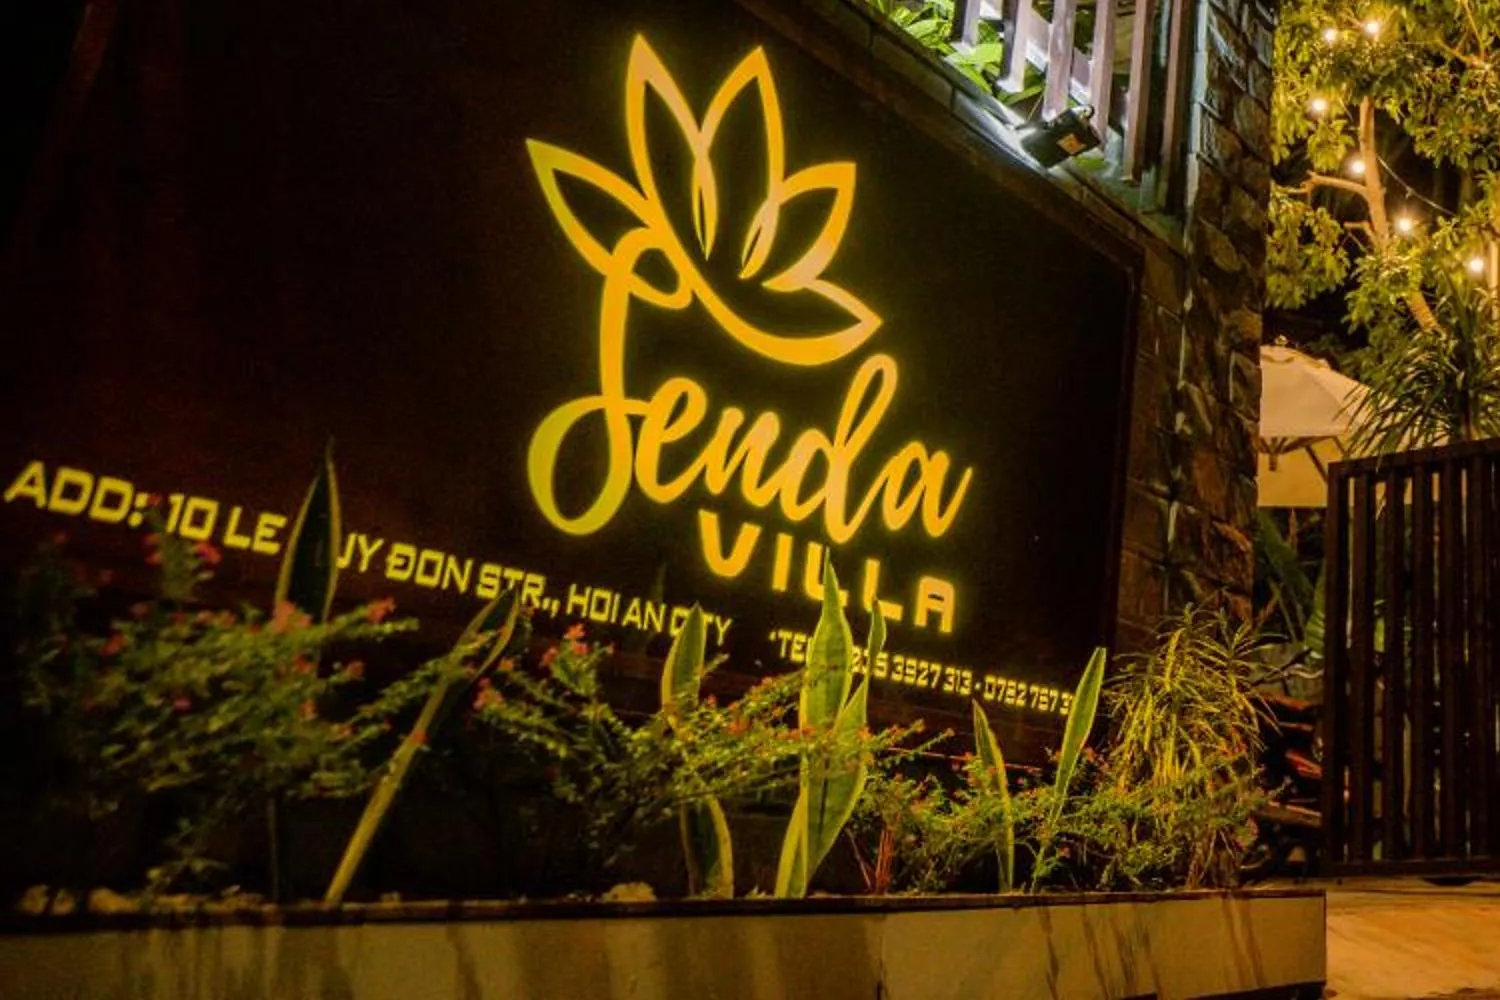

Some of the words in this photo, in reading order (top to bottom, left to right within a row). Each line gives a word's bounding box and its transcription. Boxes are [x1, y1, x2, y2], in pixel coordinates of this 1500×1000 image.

[3, 460, 150, 527] ADD:
[166, 493, 219, 540] 10
[223, 506, 288, 554] LE
[566, 583, 621, 624] HOI
[622, 597, 667, 633] AN
[670, 606, 734, 647] CTY
[698, 508, 956, 633] VILLA
